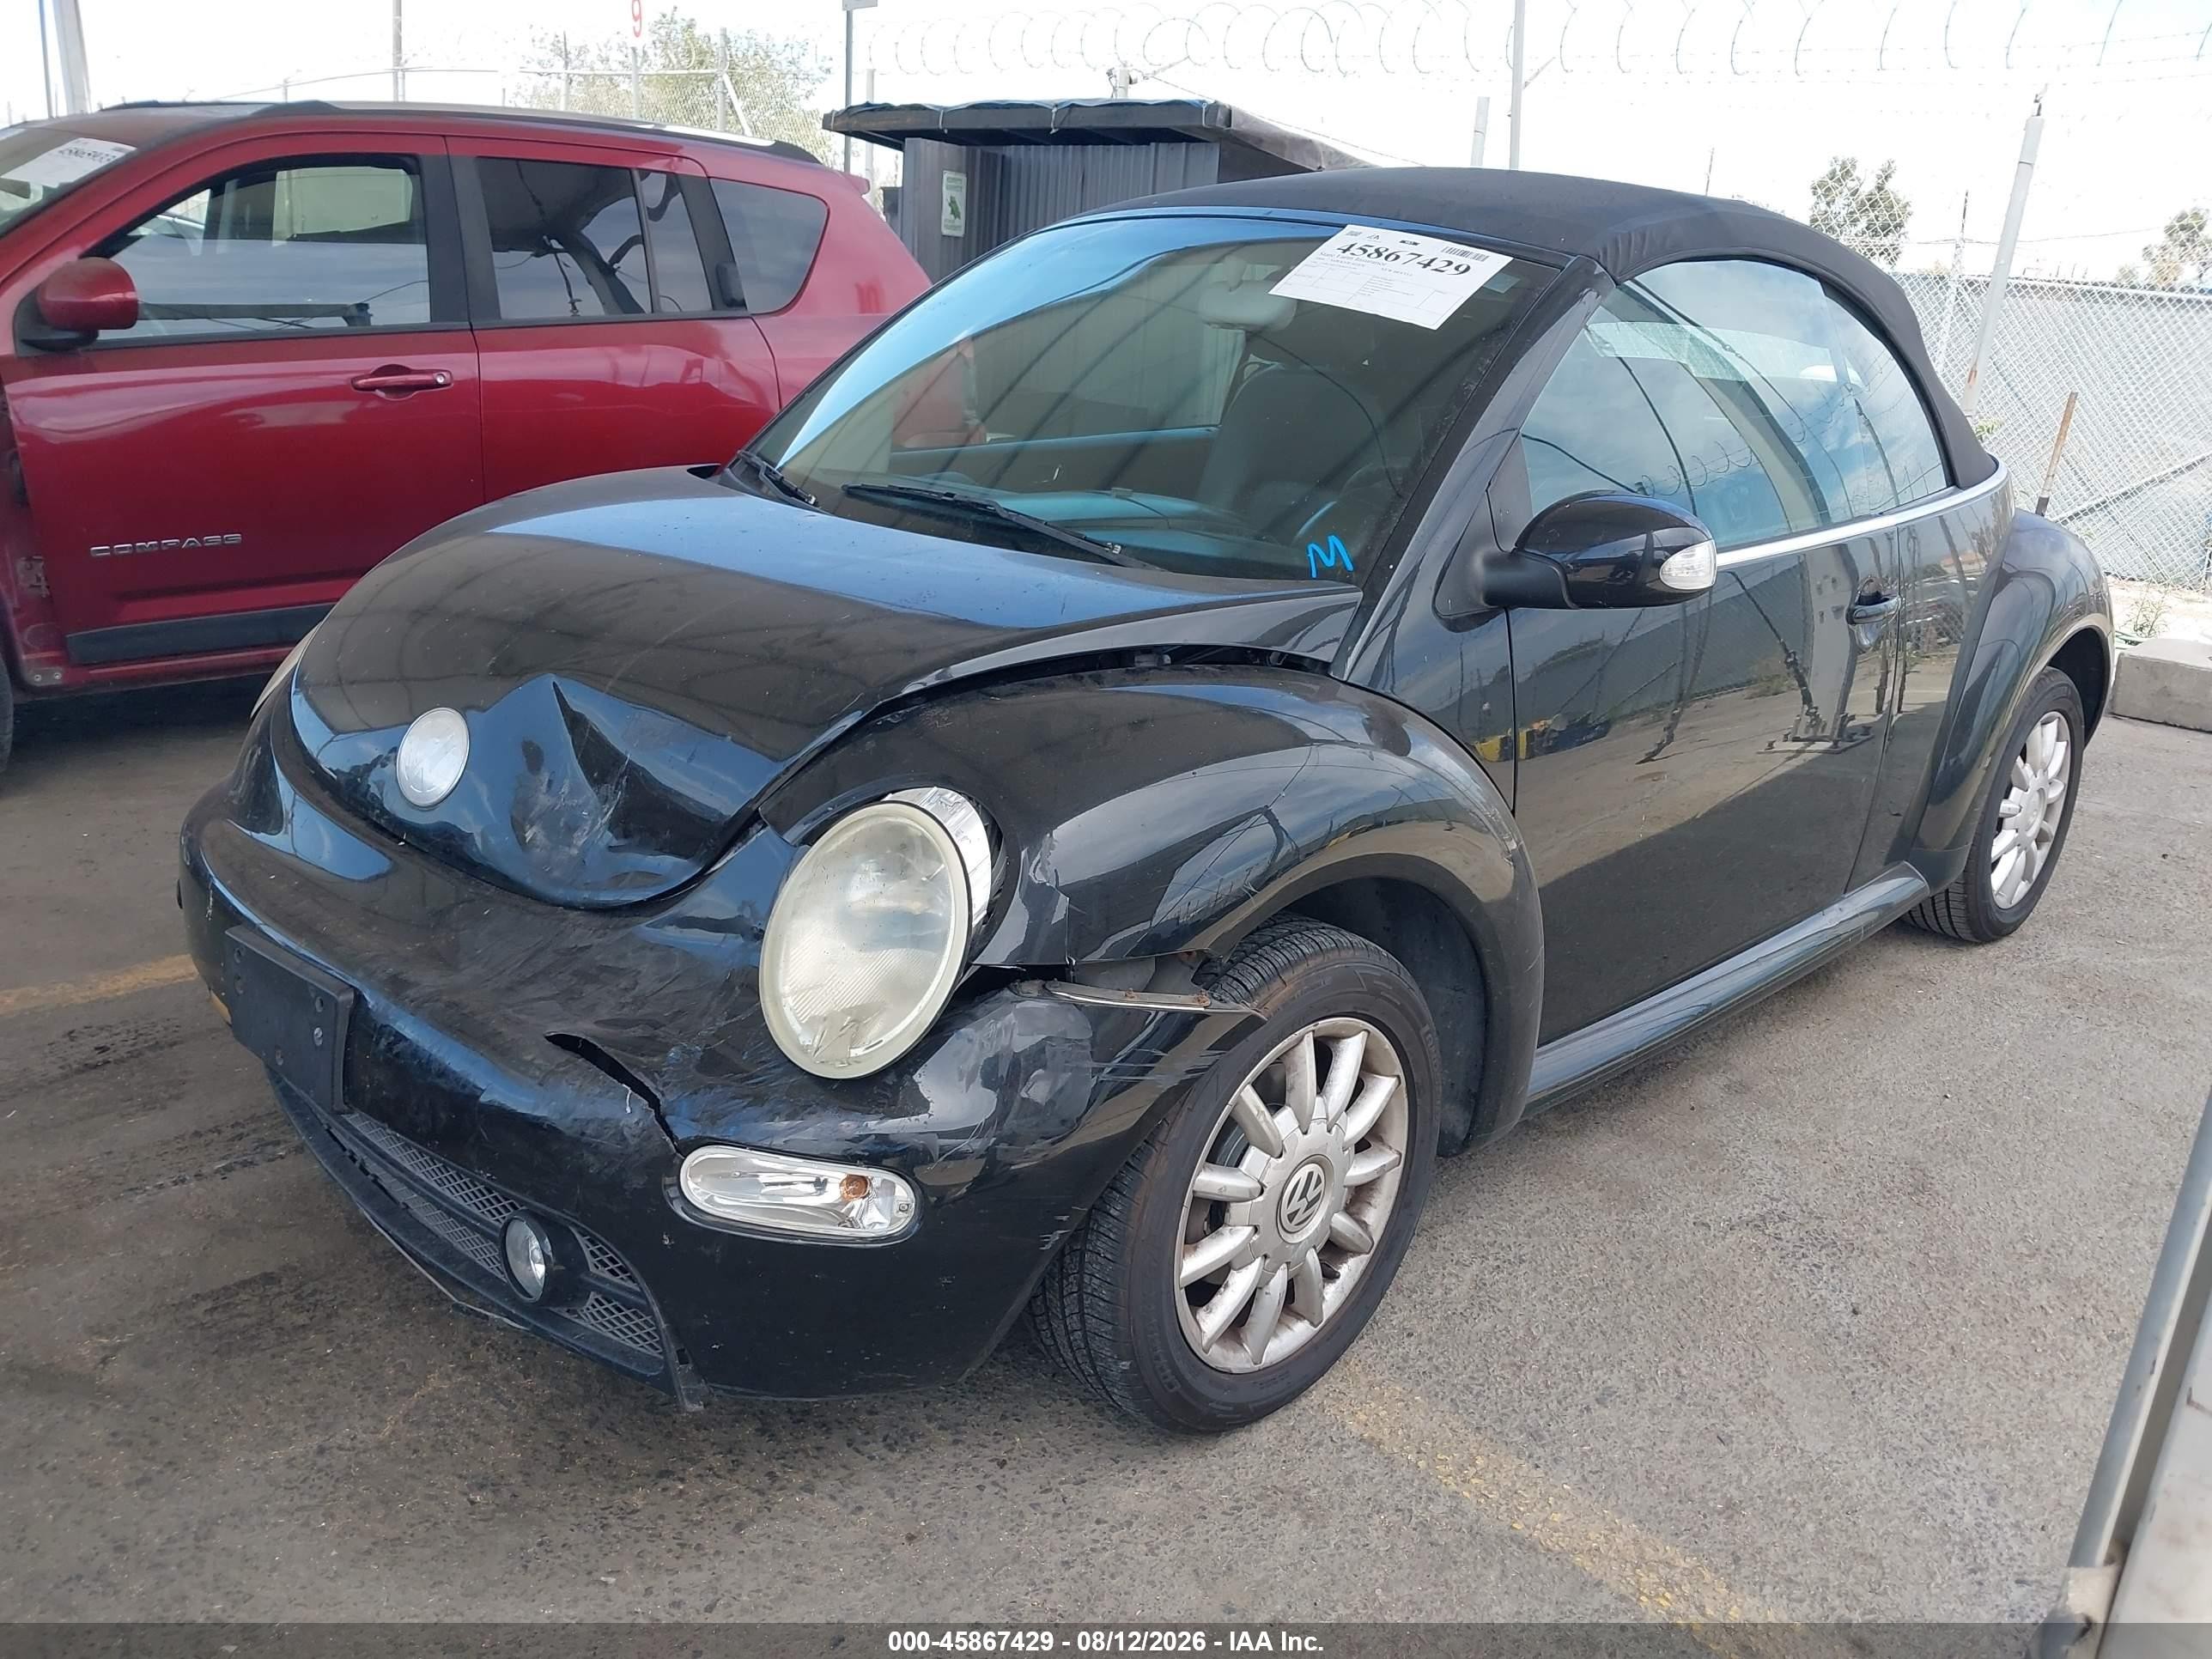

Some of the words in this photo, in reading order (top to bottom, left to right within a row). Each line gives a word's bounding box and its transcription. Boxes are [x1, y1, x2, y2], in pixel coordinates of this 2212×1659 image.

[1335, 240, 1472, 276] 45867429
[89, 533, 242, 557] COMPASS
[1307, 534, 1354, 579] M
